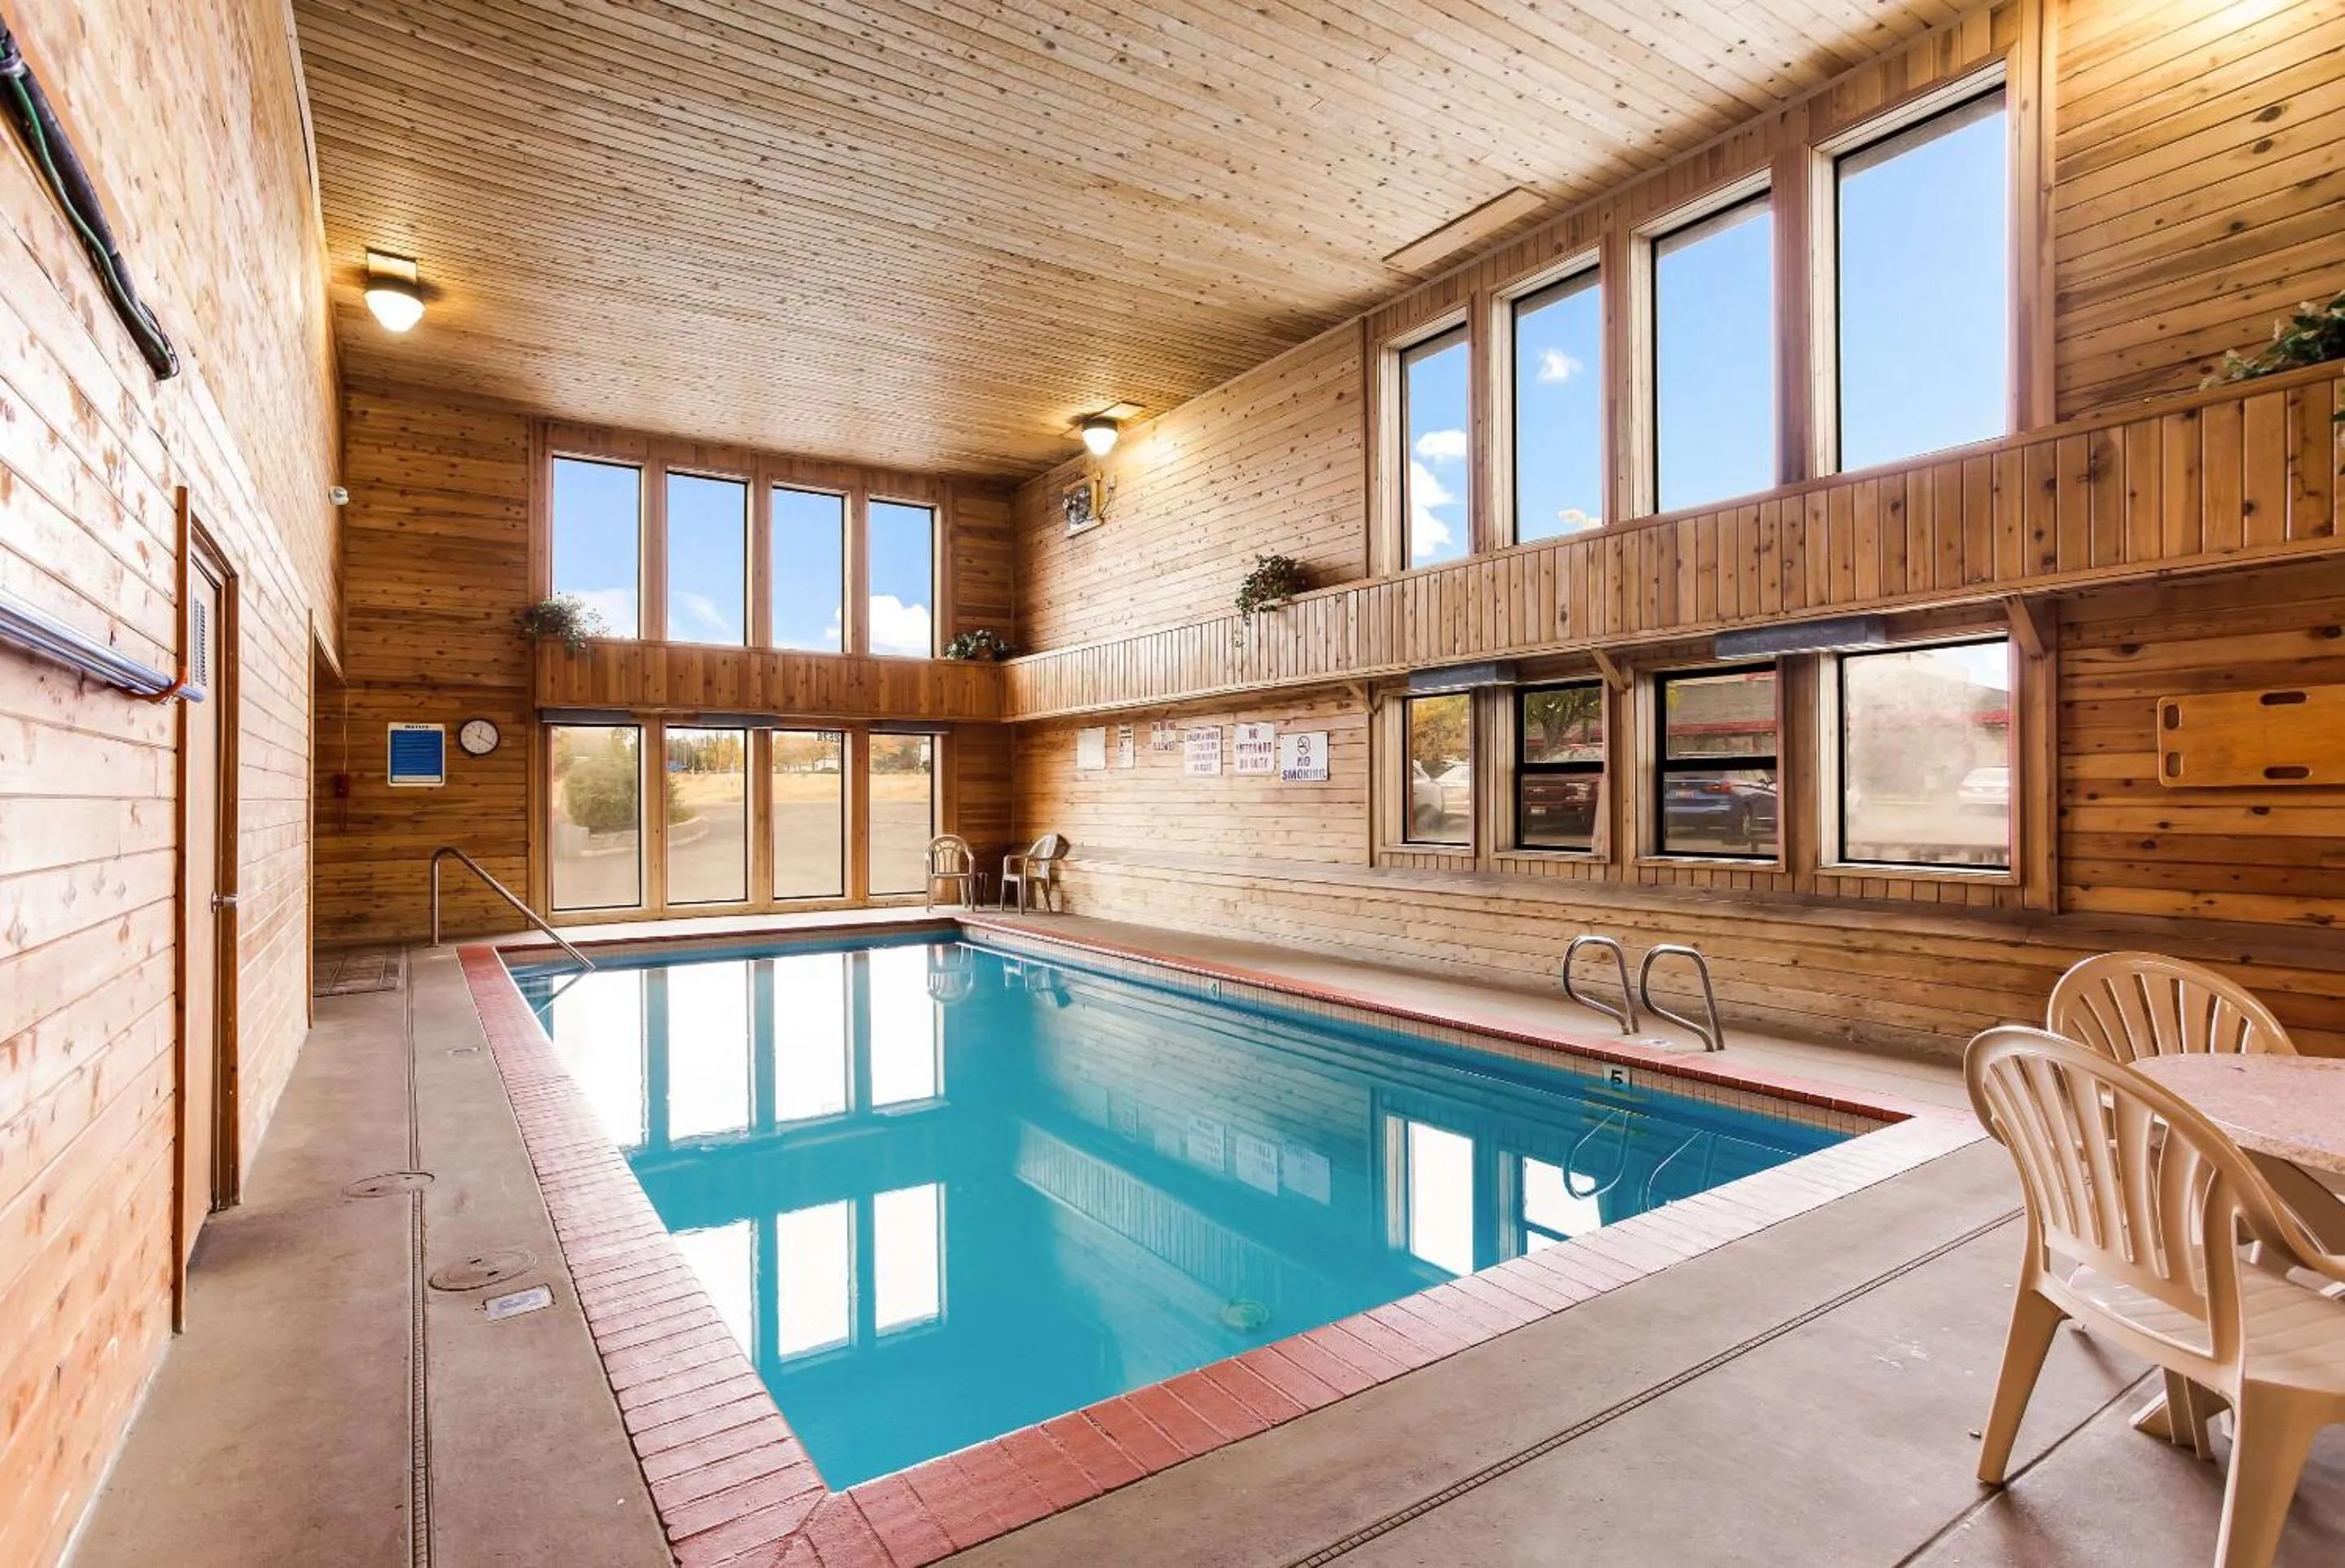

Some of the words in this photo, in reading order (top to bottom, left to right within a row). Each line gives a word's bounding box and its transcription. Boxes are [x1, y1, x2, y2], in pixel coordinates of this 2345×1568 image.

[1298, 756, 1311, 767] NO
[1282, 768, 1326, 780] SMOKING
[1610, 1068, 1623, 1085] 5
